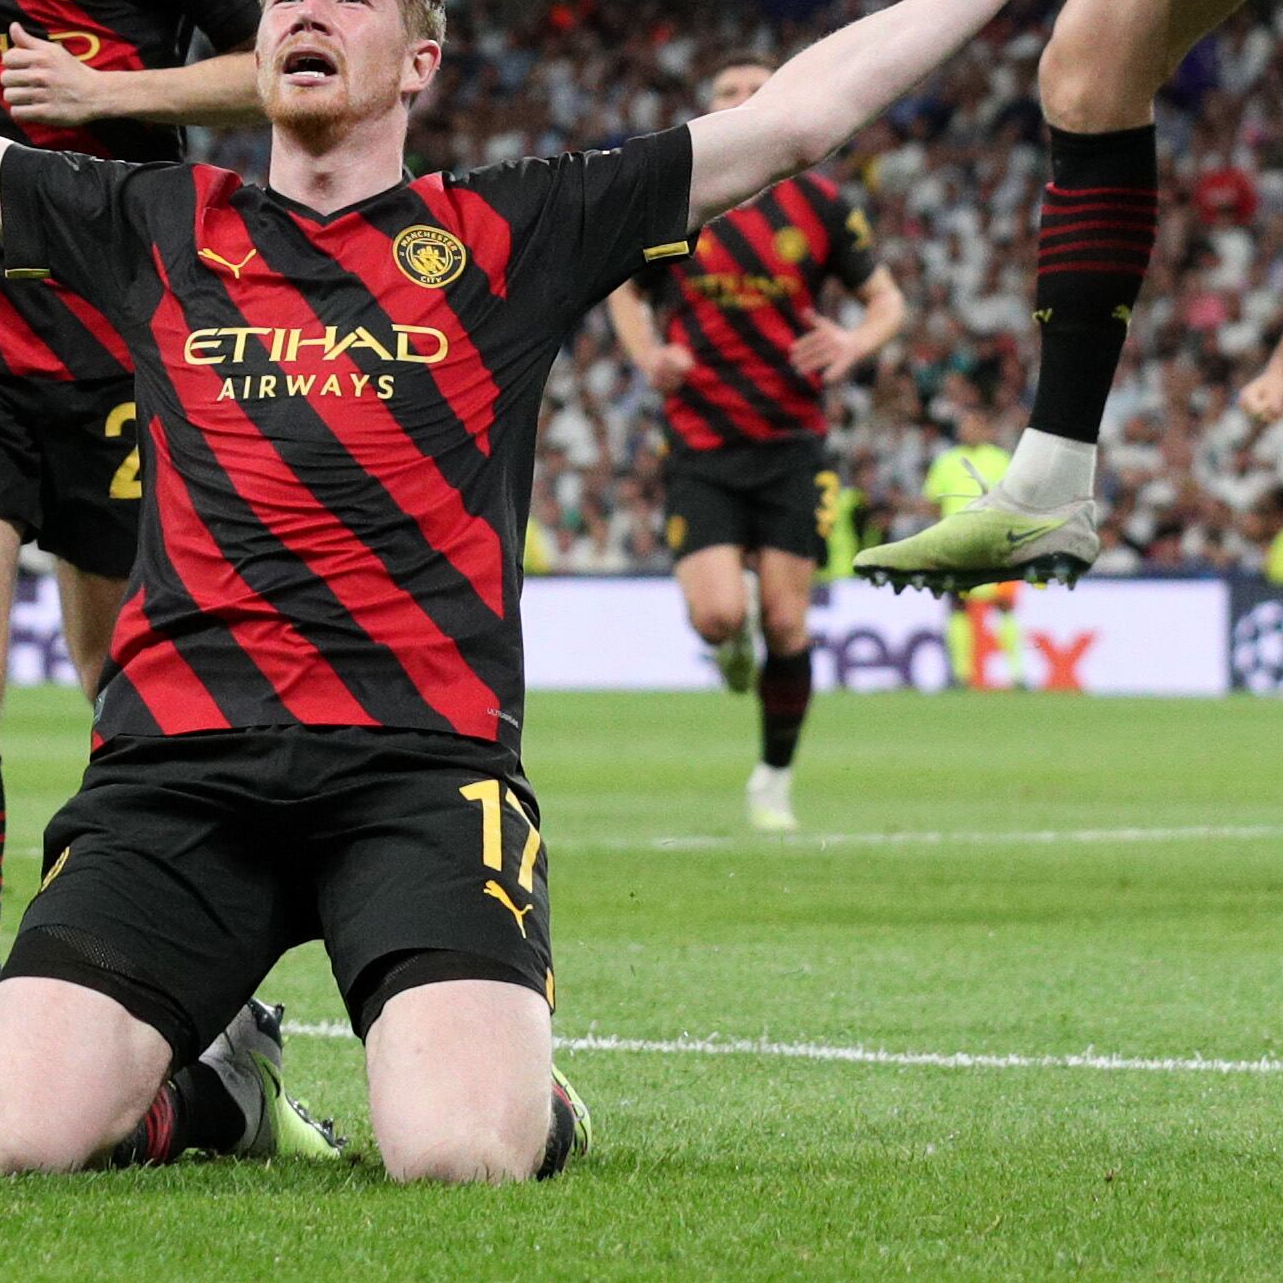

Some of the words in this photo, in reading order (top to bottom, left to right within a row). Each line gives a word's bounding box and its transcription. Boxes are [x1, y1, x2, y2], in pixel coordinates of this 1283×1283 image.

[400, 231, 458, 251] MANCHESTER
[420, 276, 442, 284] CITY
[183, 324, 448, 365] ETIHAD
[216, 374, 395, 401] AIRWAYS
[459, 779, 540, 893] 17
